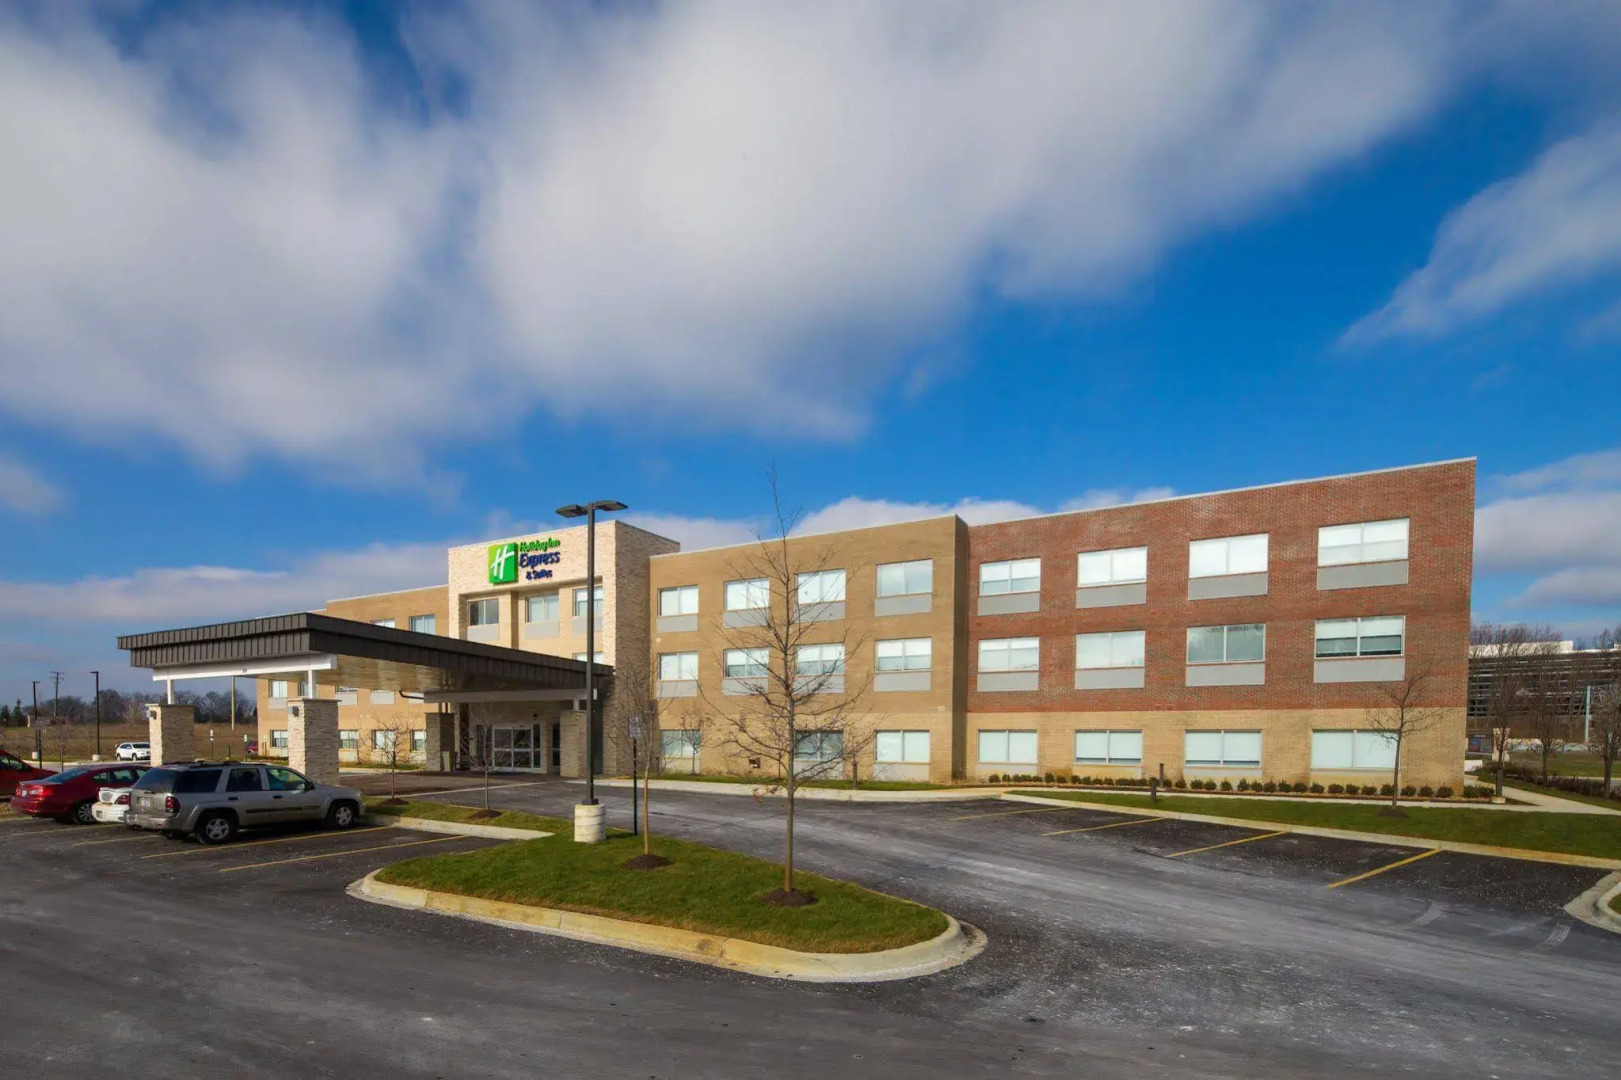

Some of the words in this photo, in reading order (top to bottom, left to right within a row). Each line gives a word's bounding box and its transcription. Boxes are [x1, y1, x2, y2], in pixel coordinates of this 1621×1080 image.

[519, 540, 548, 552] Holiday
[547, 537, 561, 548] Inn
[525, 571, 532, 580] &
